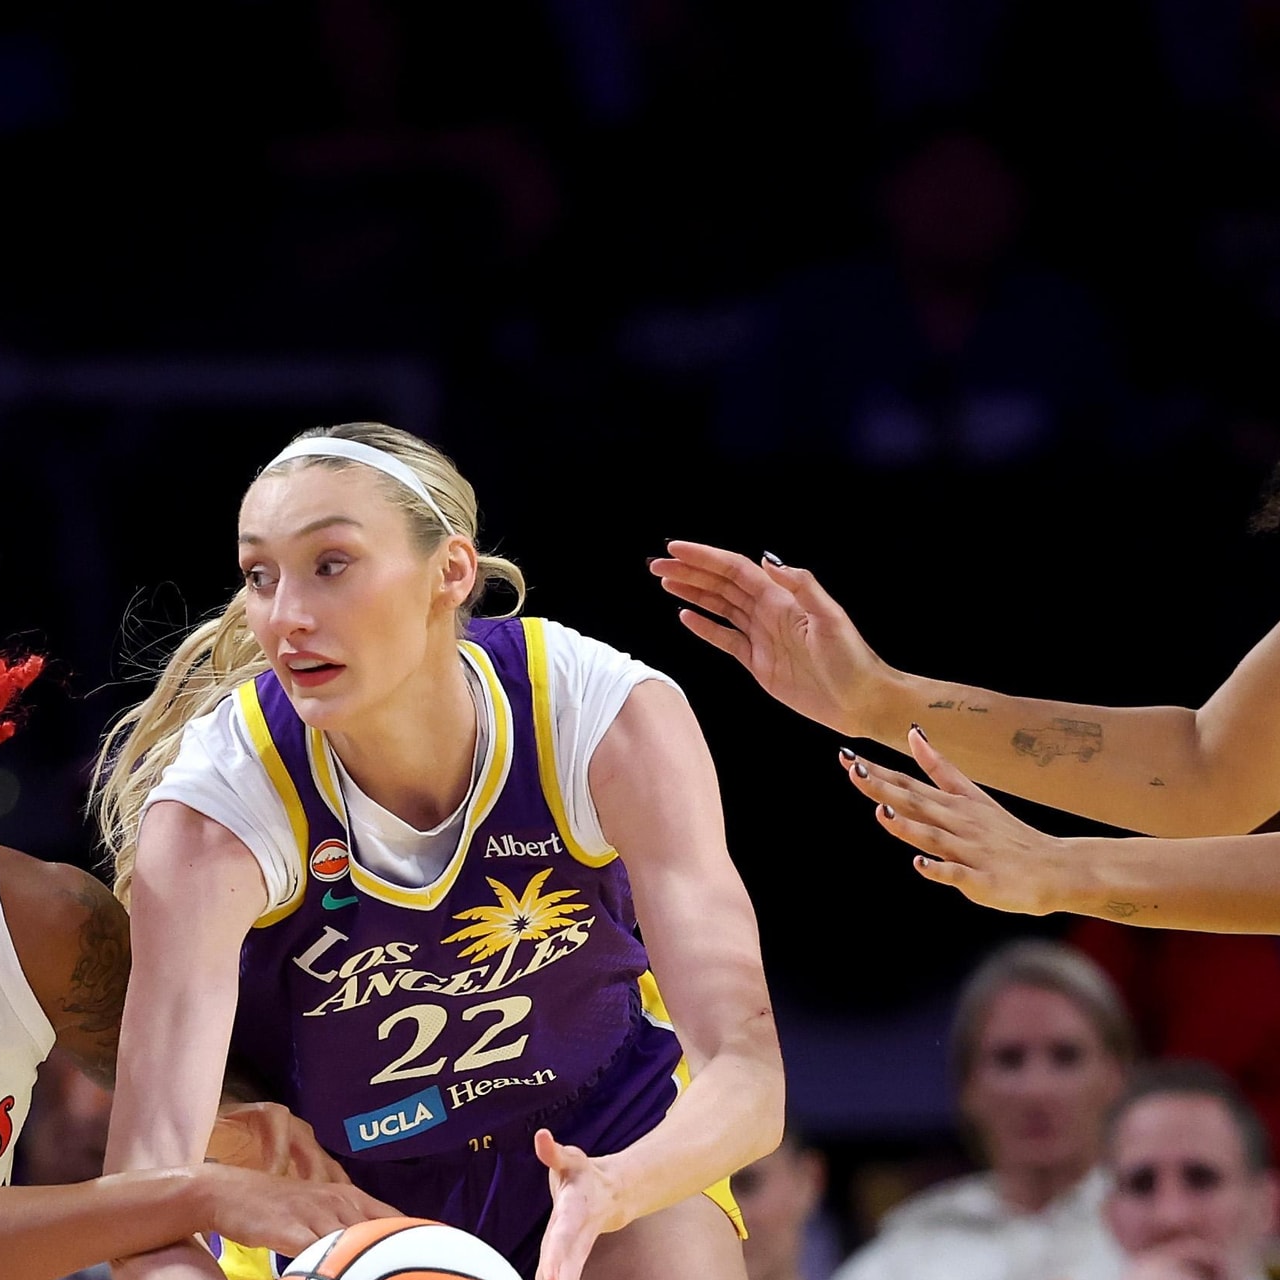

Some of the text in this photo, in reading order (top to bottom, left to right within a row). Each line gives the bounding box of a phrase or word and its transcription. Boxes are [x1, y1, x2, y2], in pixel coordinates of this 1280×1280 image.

[483, 833, 563, 859] Albert
[370, 995, 533, 1085] 22
[359, 1068, 557, 1142] UCLA Health
